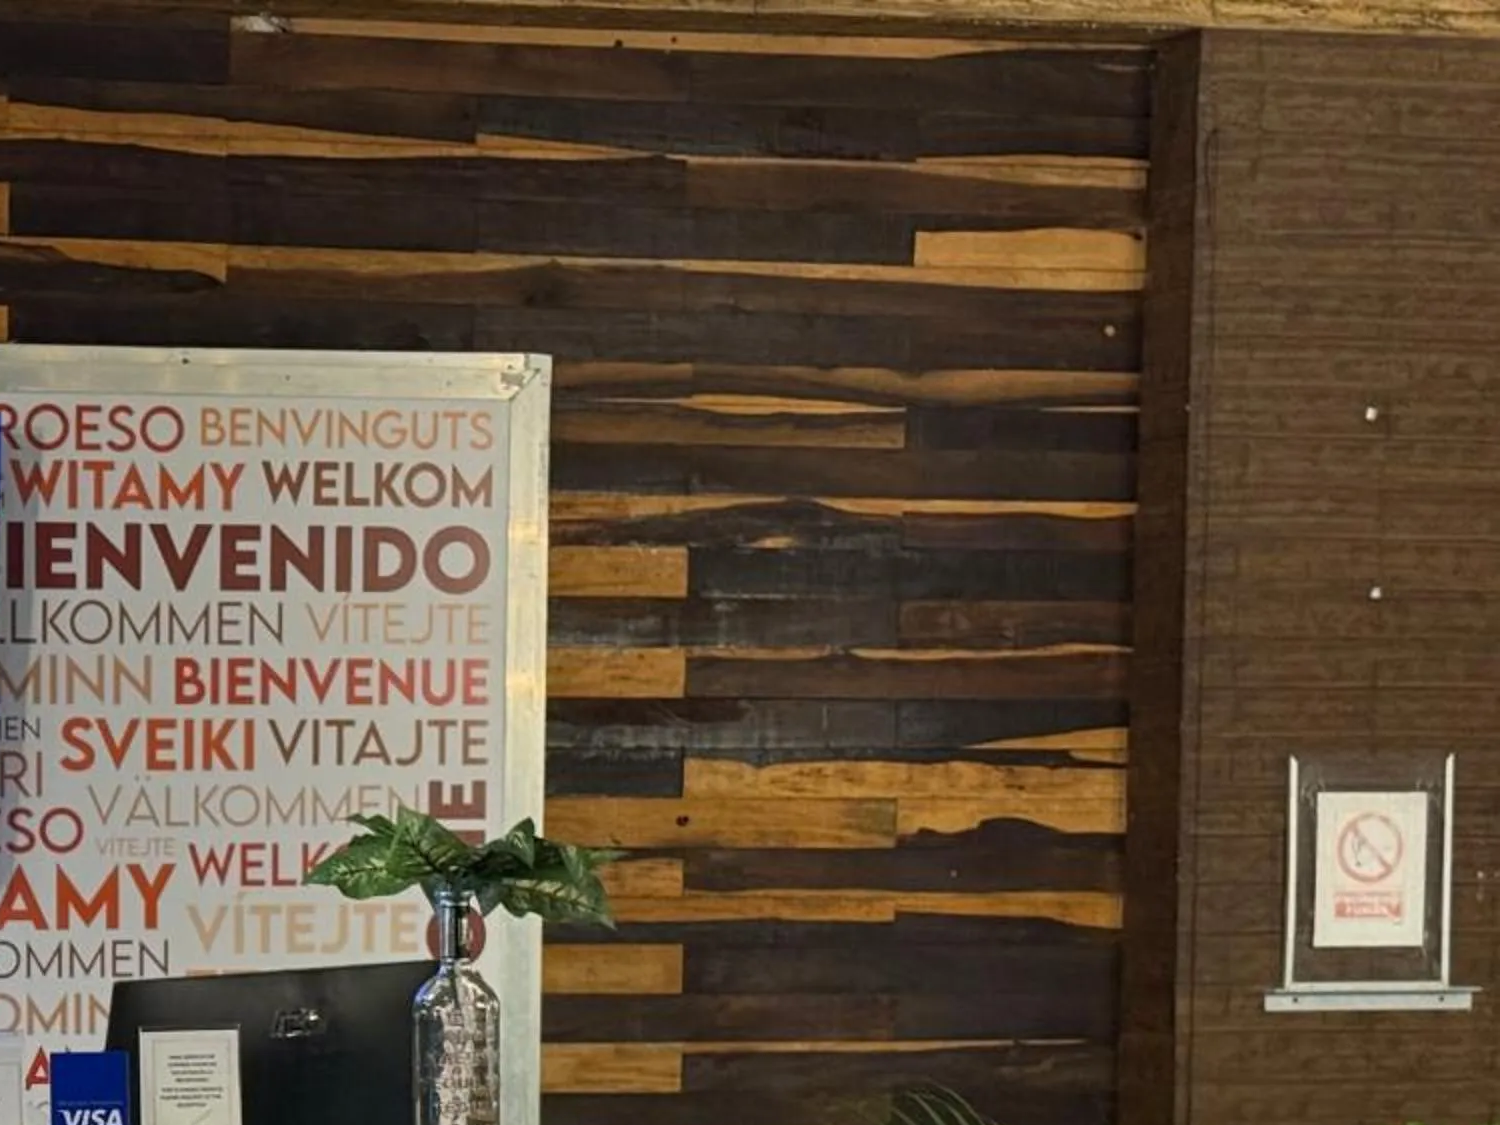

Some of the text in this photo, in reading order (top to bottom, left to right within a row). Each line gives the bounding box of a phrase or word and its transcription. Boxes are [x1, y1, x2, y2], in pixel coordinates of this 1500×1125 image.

[201, 407, 494, 451] BENVINGUTS
[9, 460, 494, 511] WITAMY WELKOM
[6, 521, 491, 595] IENVENIDO
[306, 591, 492, 646] VÍTEJTE
[174, 657, 489, 706] BIENVENUE
[60, 716, 489, 771] SVEIKI VITAJTE
[185, 889, 420, 956] VÍTEJTE
